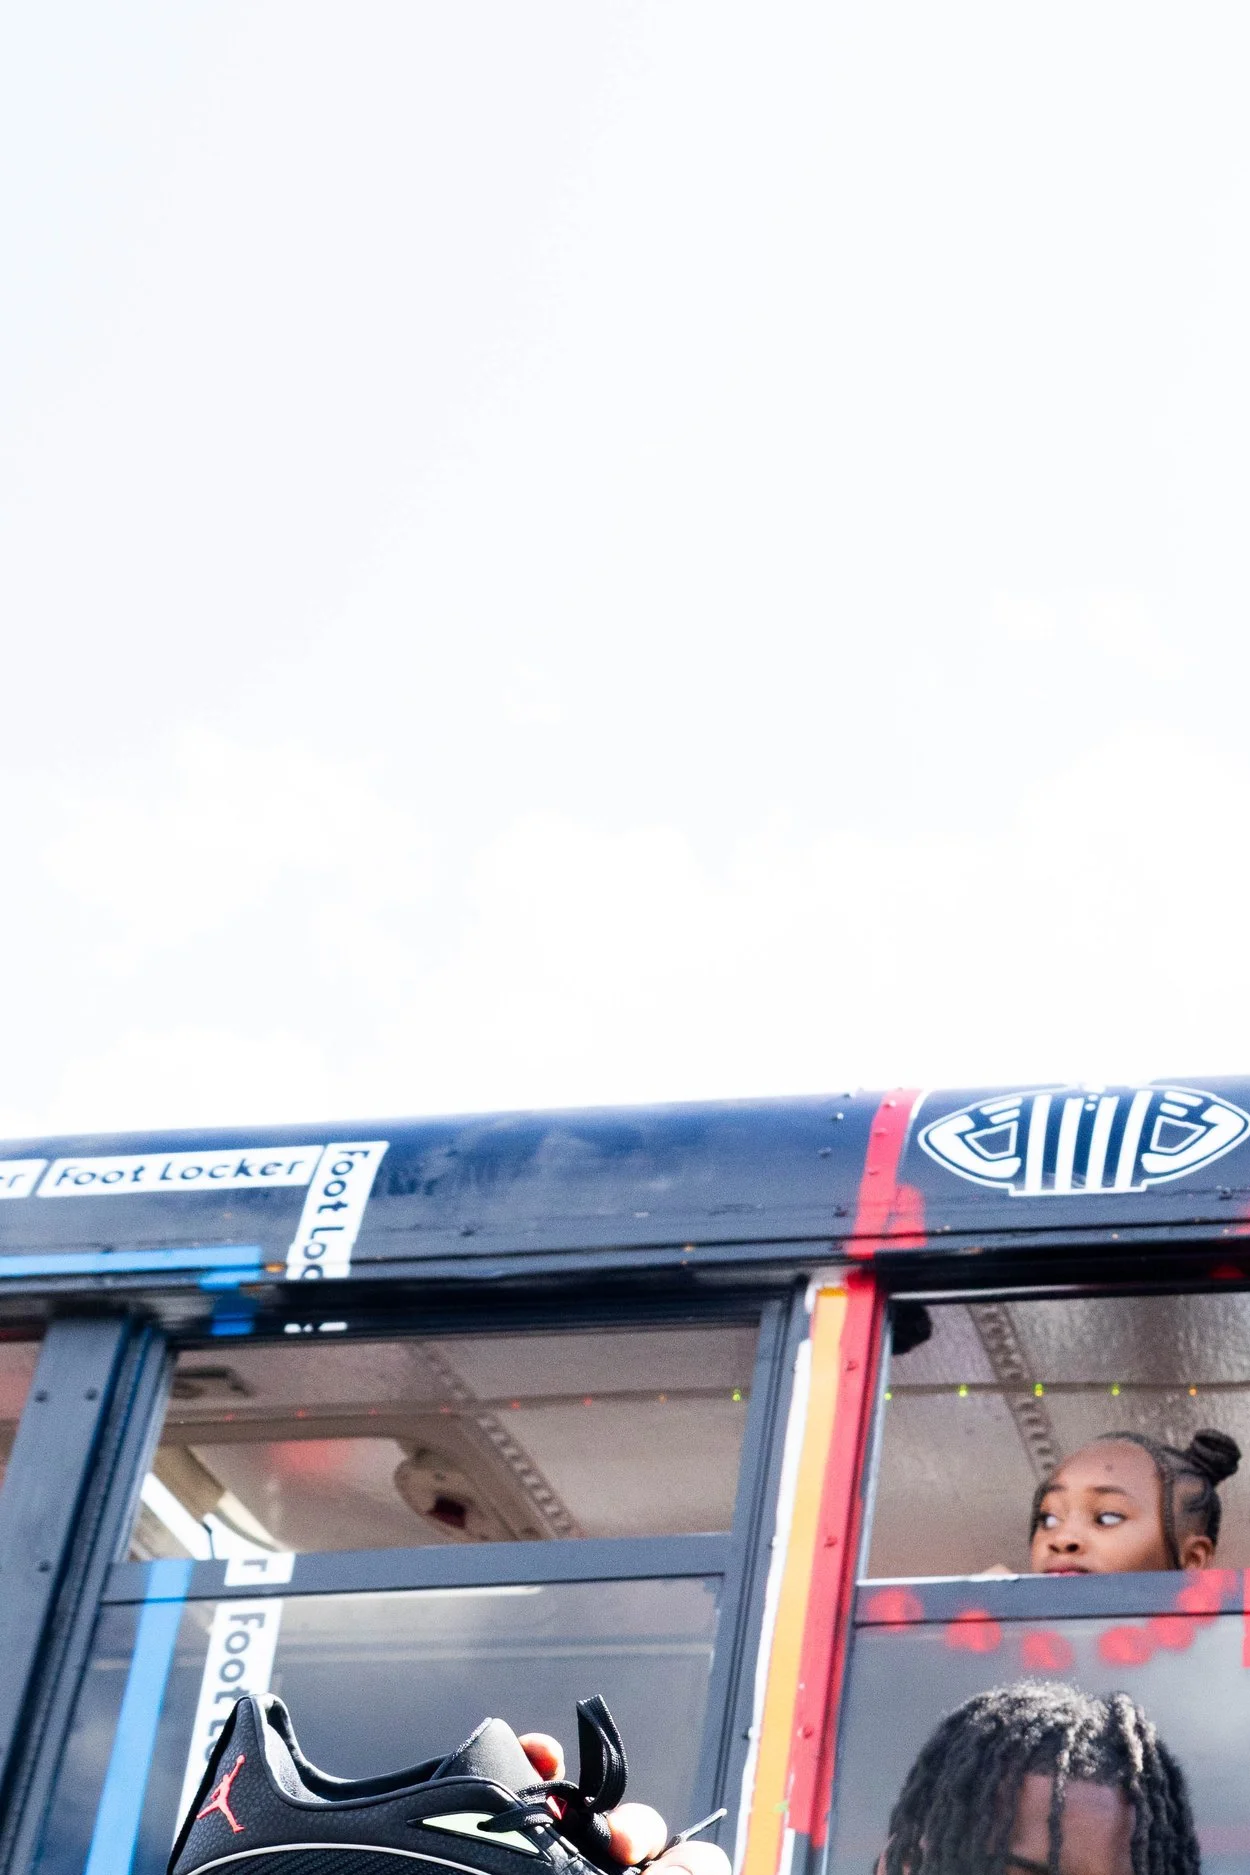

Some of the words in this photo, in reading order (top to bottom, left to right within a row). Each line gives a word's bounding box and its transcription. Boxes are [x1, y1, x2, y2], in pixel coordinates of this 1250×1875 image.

[55, 1163, 145, 1187] Foot
[159, 1157, 304, 1181] Locker
[318, 1150, 369, 1214] Foot
